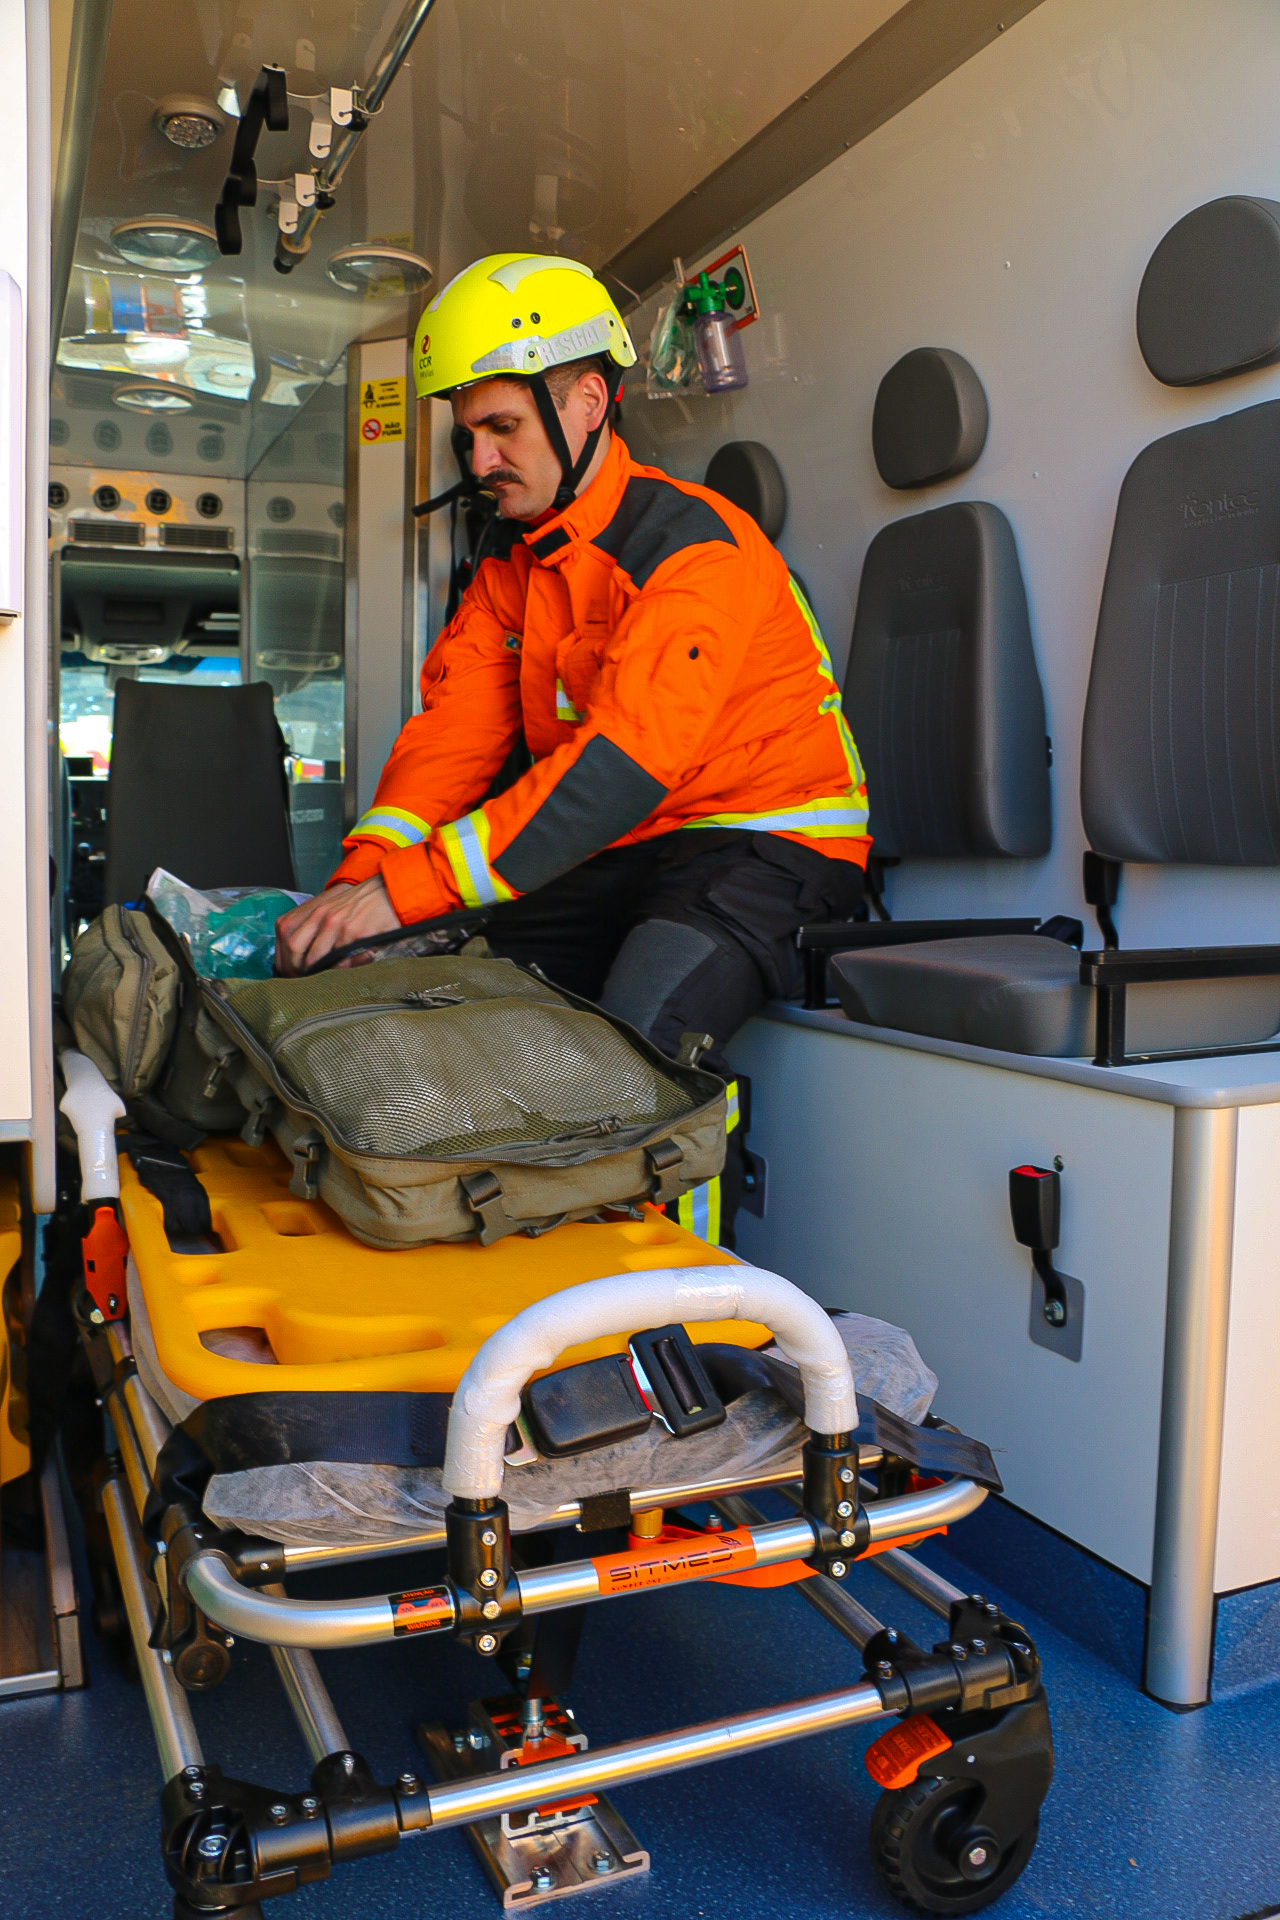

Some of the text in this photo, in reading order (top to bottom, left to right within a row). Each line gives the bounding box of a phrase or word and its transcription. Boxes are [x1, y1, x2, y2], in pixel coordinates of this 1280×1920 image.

[536, 317, 612, 367] RESGATE
[419, 355, 432, 369] CCR
[609, 1548, 733, 1582] SITMED
[406, 1619, 441, 1630] WARNING
